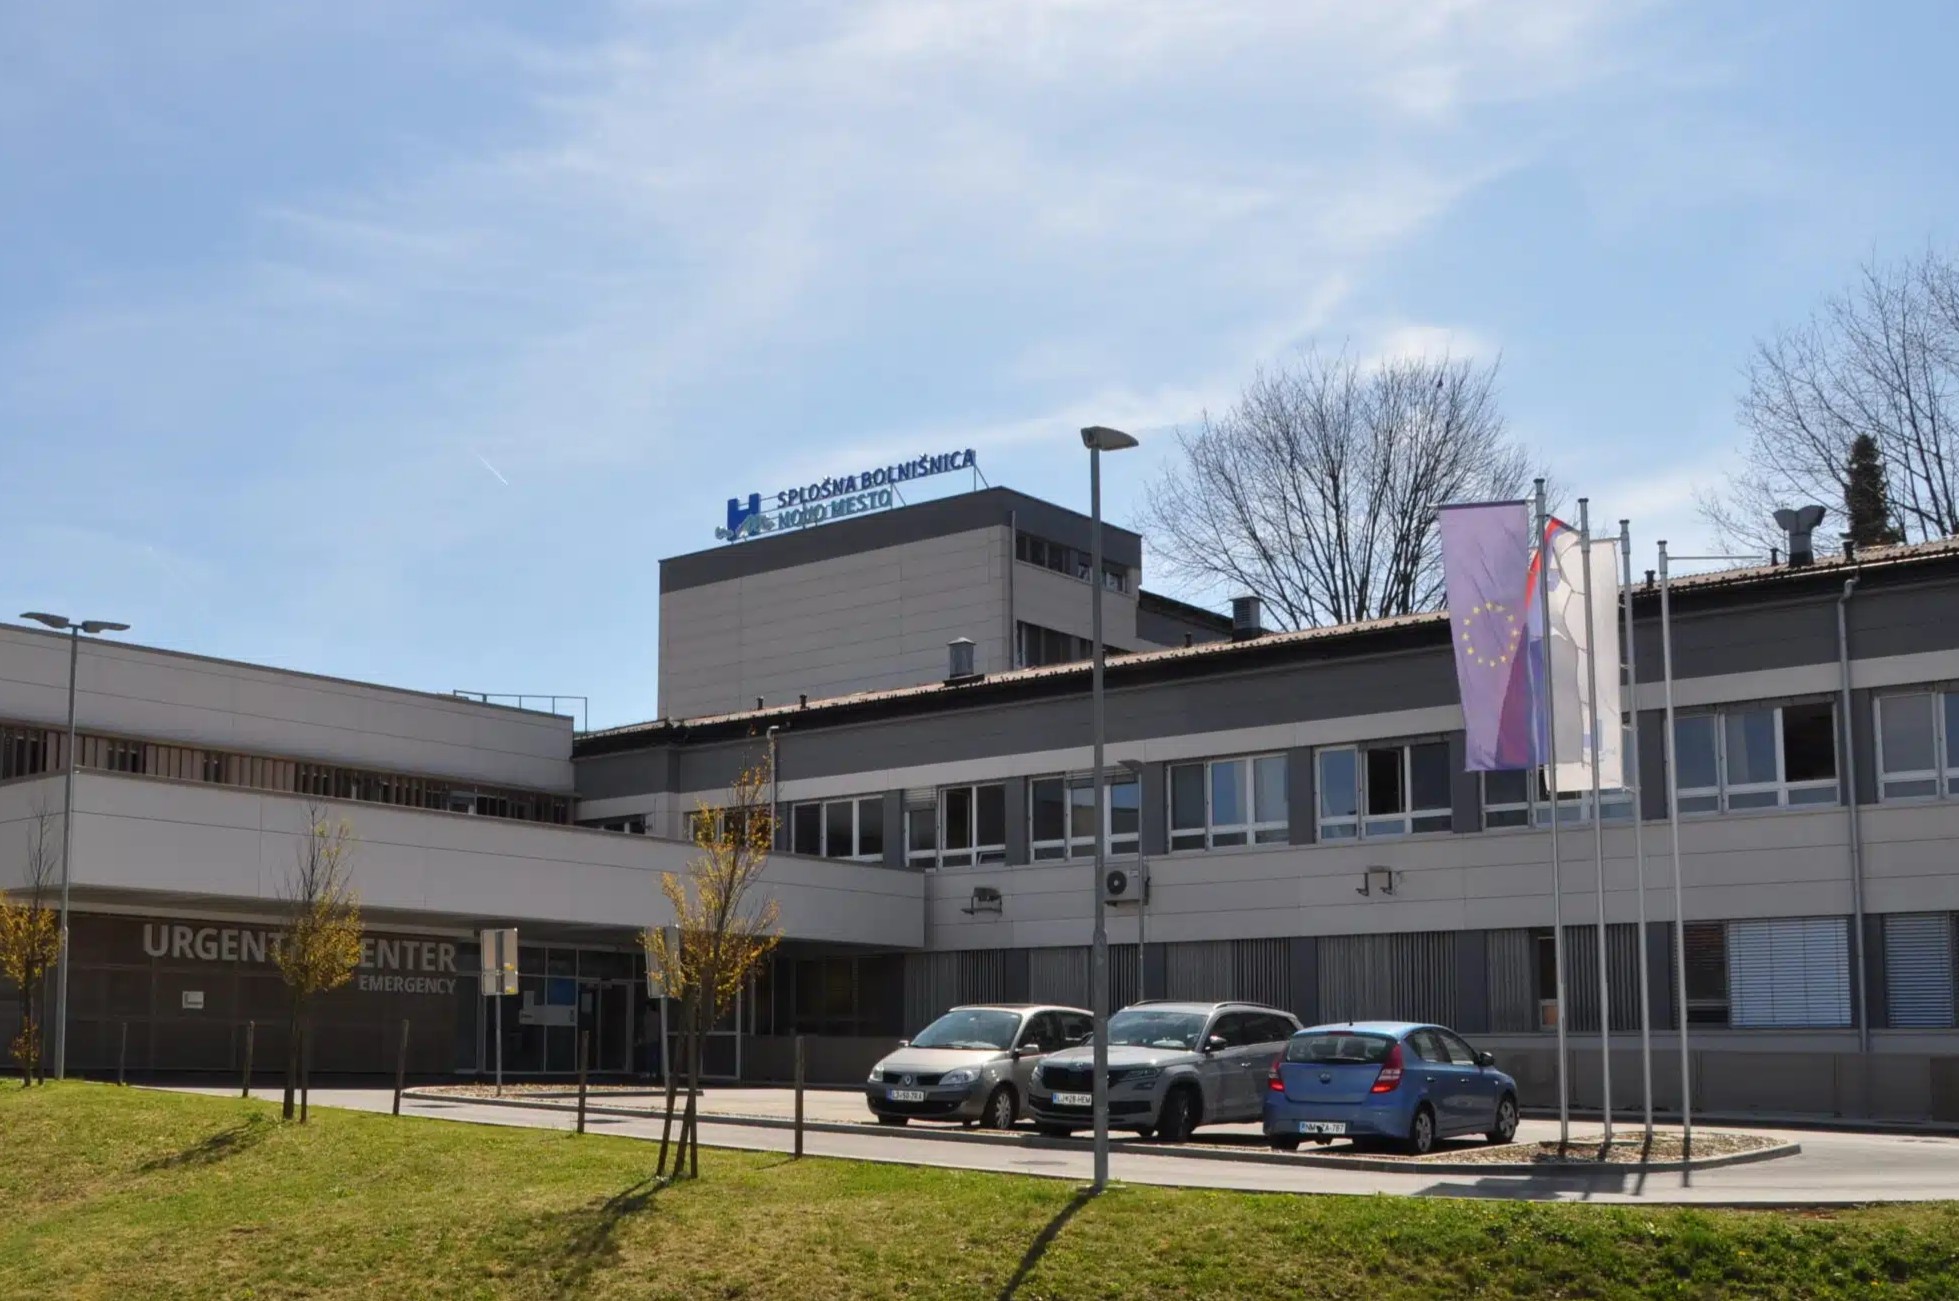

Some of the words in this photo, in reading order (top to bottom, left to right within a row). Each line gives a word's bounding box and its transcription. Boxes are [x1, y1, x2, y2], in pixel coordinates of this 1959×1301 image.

[777, 475, 856, 509] SPLOŠNA
[861, 448, 976, 490] BOLNIŠNICA
[777, 504, 827, 530] NOVO
[831, 488, 892, 517] MESTO
[345, 936, 456, 973] ENTER
[358, 974, 456, 995] EMERGENCY
